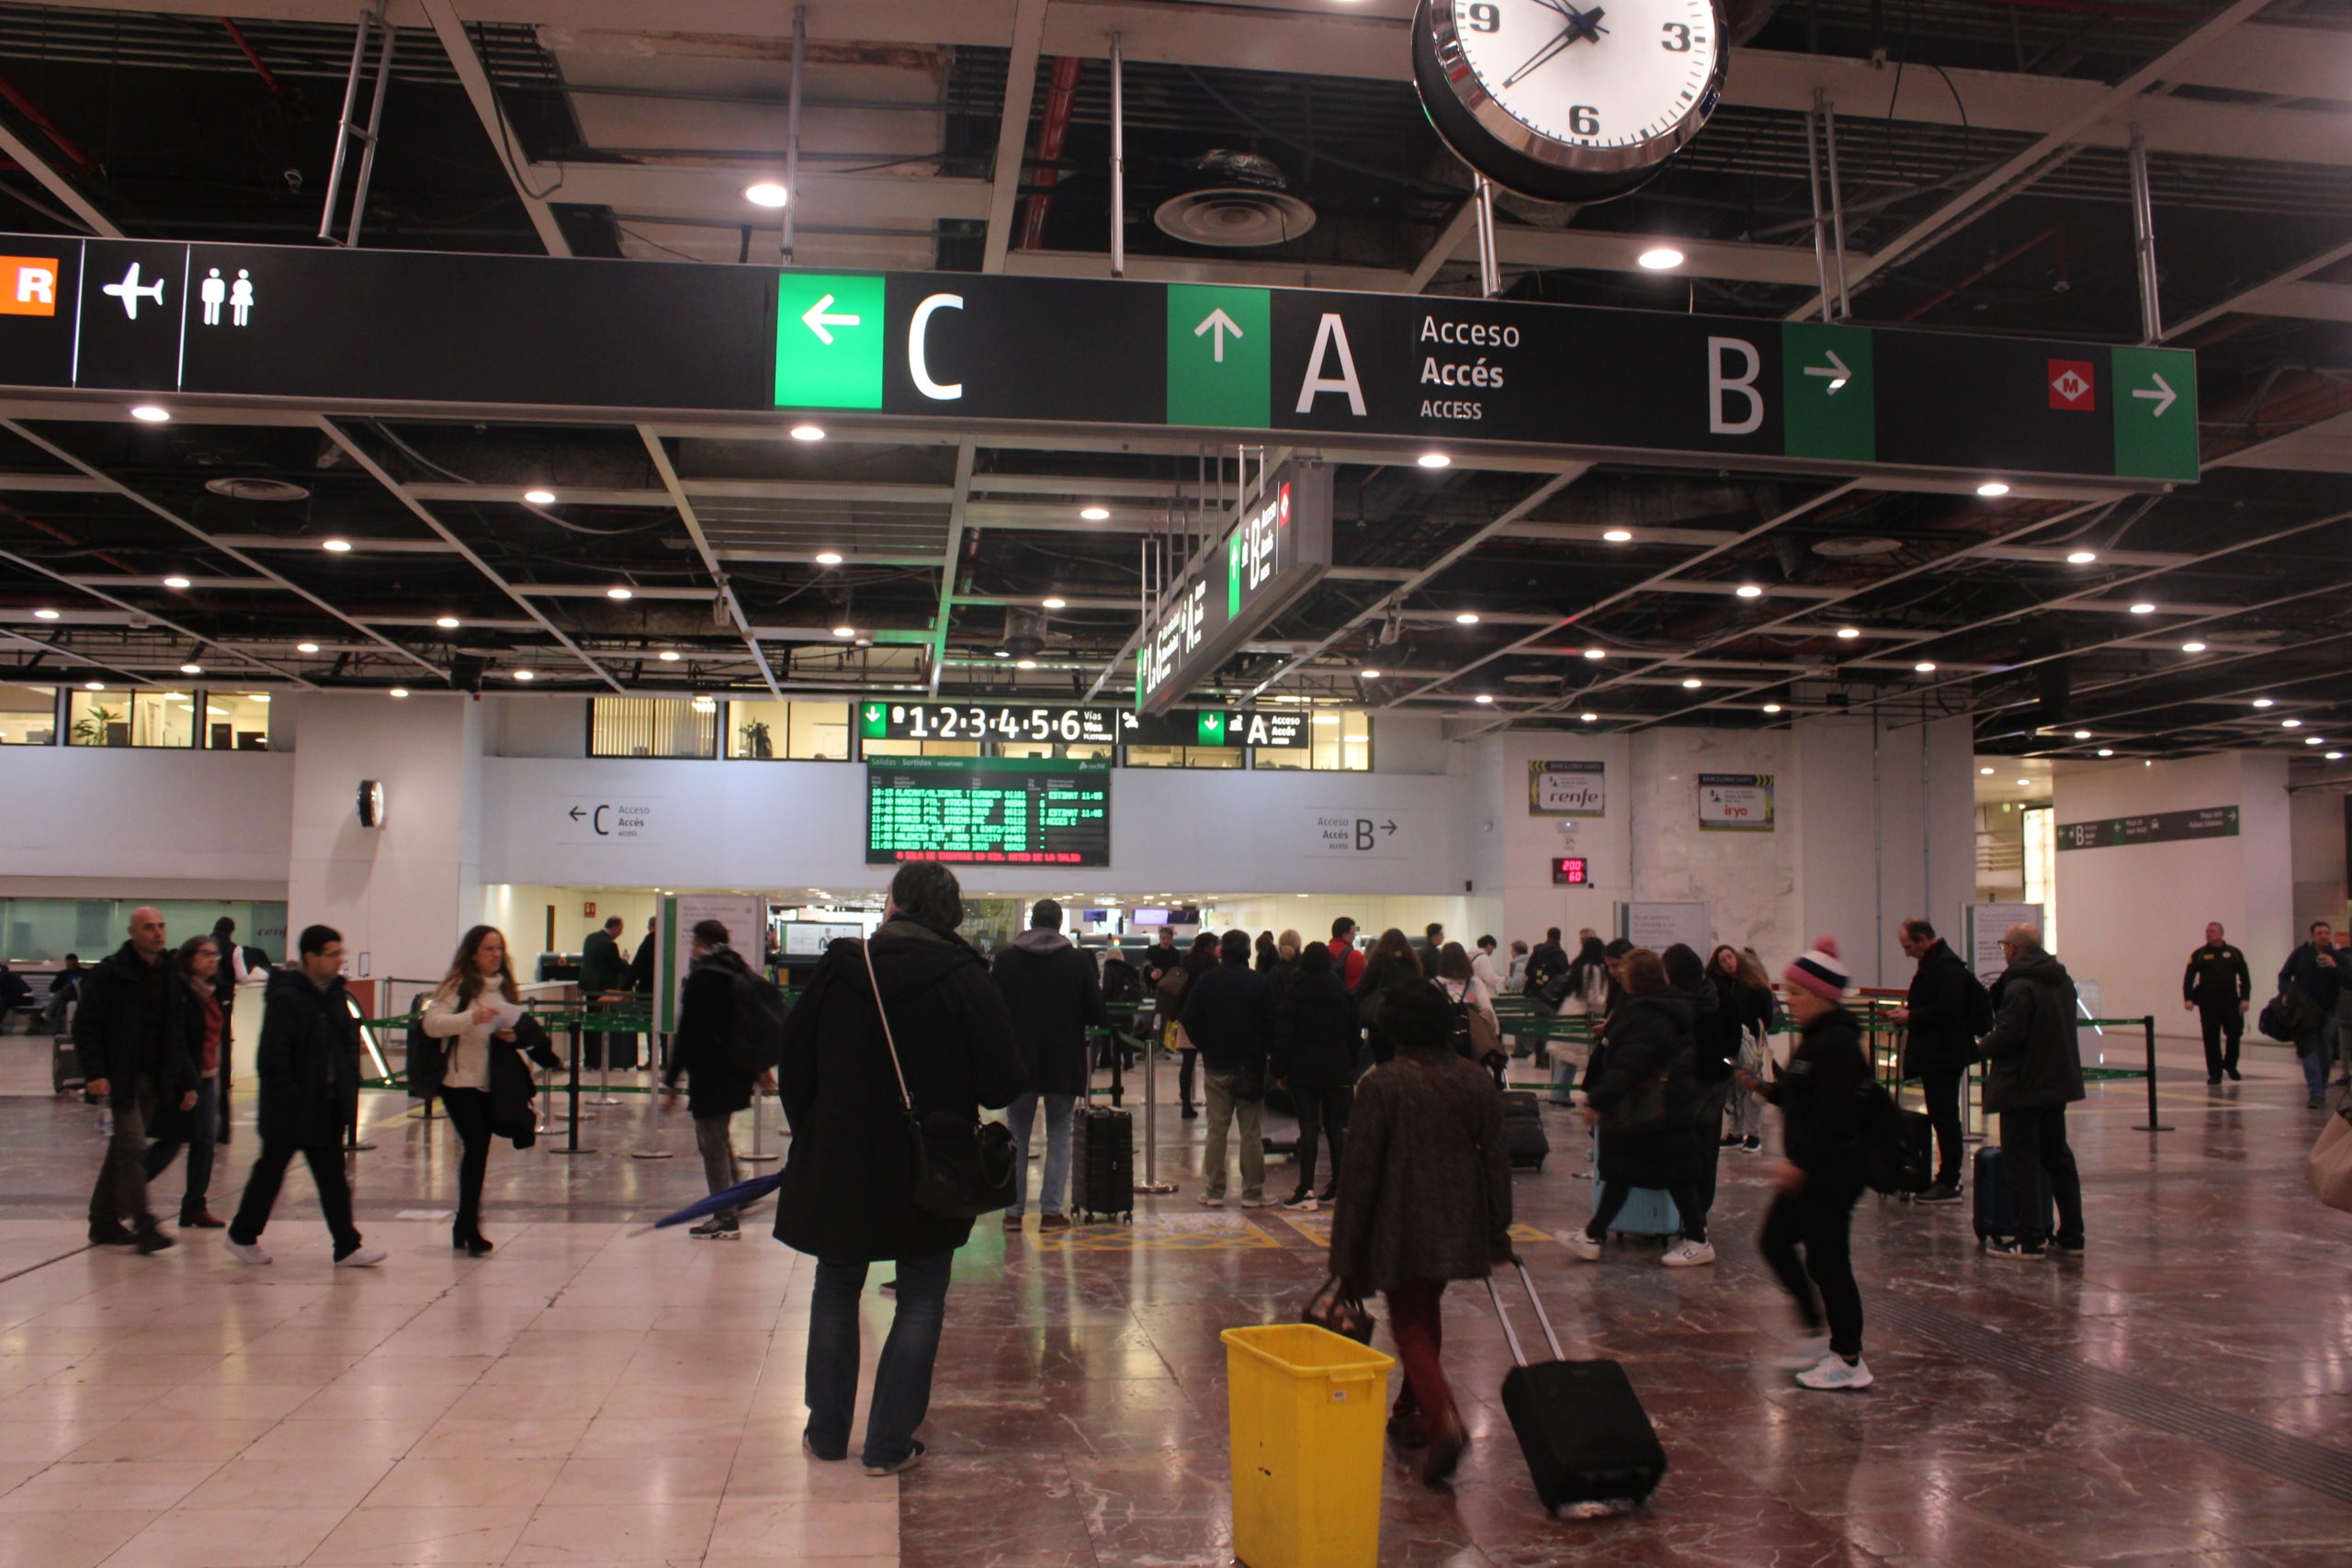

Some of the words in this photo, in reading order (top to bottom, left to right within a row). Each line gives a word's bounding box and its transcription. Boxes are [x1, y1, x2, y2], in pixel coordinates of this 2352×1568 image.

[1470, 5, 1500, 33] 9
[1661, 22, 1691, 52] 3
[1569, 105, 1600, 136] 6
[17, 266, 54, 304] R
[1420, 315, 1521, 348] Acceso
[908, 292, 964, 400] C
[1295, 312, 1367, 416] A
[1420, 355, 1505, 389] Accés
[1707, 336, 1765, 435] B
[2062, 378, 2079, 394] M
[1420, 400, 1483, 420] ACCESS
[1247, 715, 1269, 744] A
[1272, 716, 1301, 726] Acceso
[901, 759, 932, 767] Sortides
[618, 806, 650, 815] Acceso
[1550, 787, 1599, 808] renfe
[1724, 804, 1748, 818] iryo
[594, 805, 610, 835] C
[618, 818, 644, 827] Accés
[1317, 817, 1349, 827] Acceso
[1356, 818, 1374, 851] B
[2075, 825, 2085, 846] B
[257, 926, 288, 940] renf
